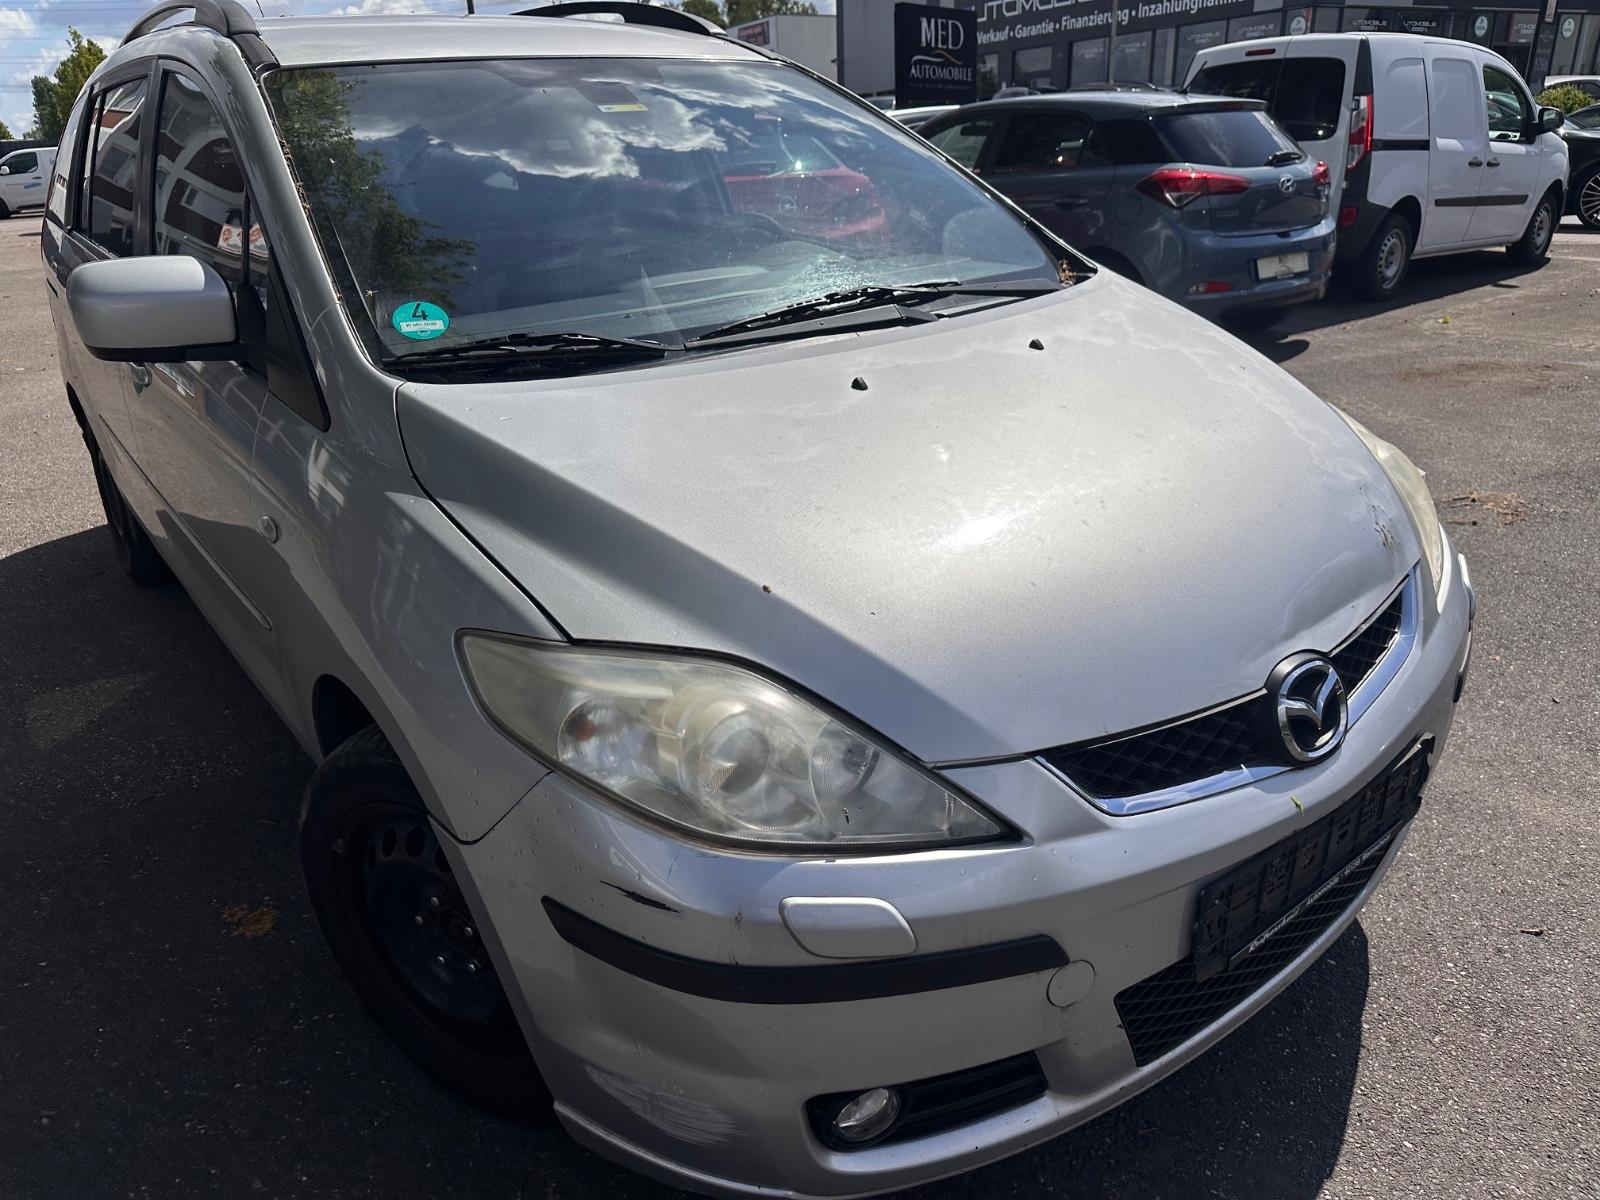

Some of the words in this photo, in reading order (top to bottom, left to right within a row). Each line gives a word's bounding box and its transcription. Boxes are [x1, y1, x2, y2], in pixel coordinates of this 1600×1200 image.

[919, 16, 964, 49] MED
[977, 26, 1009, 45] Verkauf
[1015, 19, 1054, 38] Garantie
[909, 63, 973, 82] AUTOMOBILE
[412, 303, 428, 321] 4
